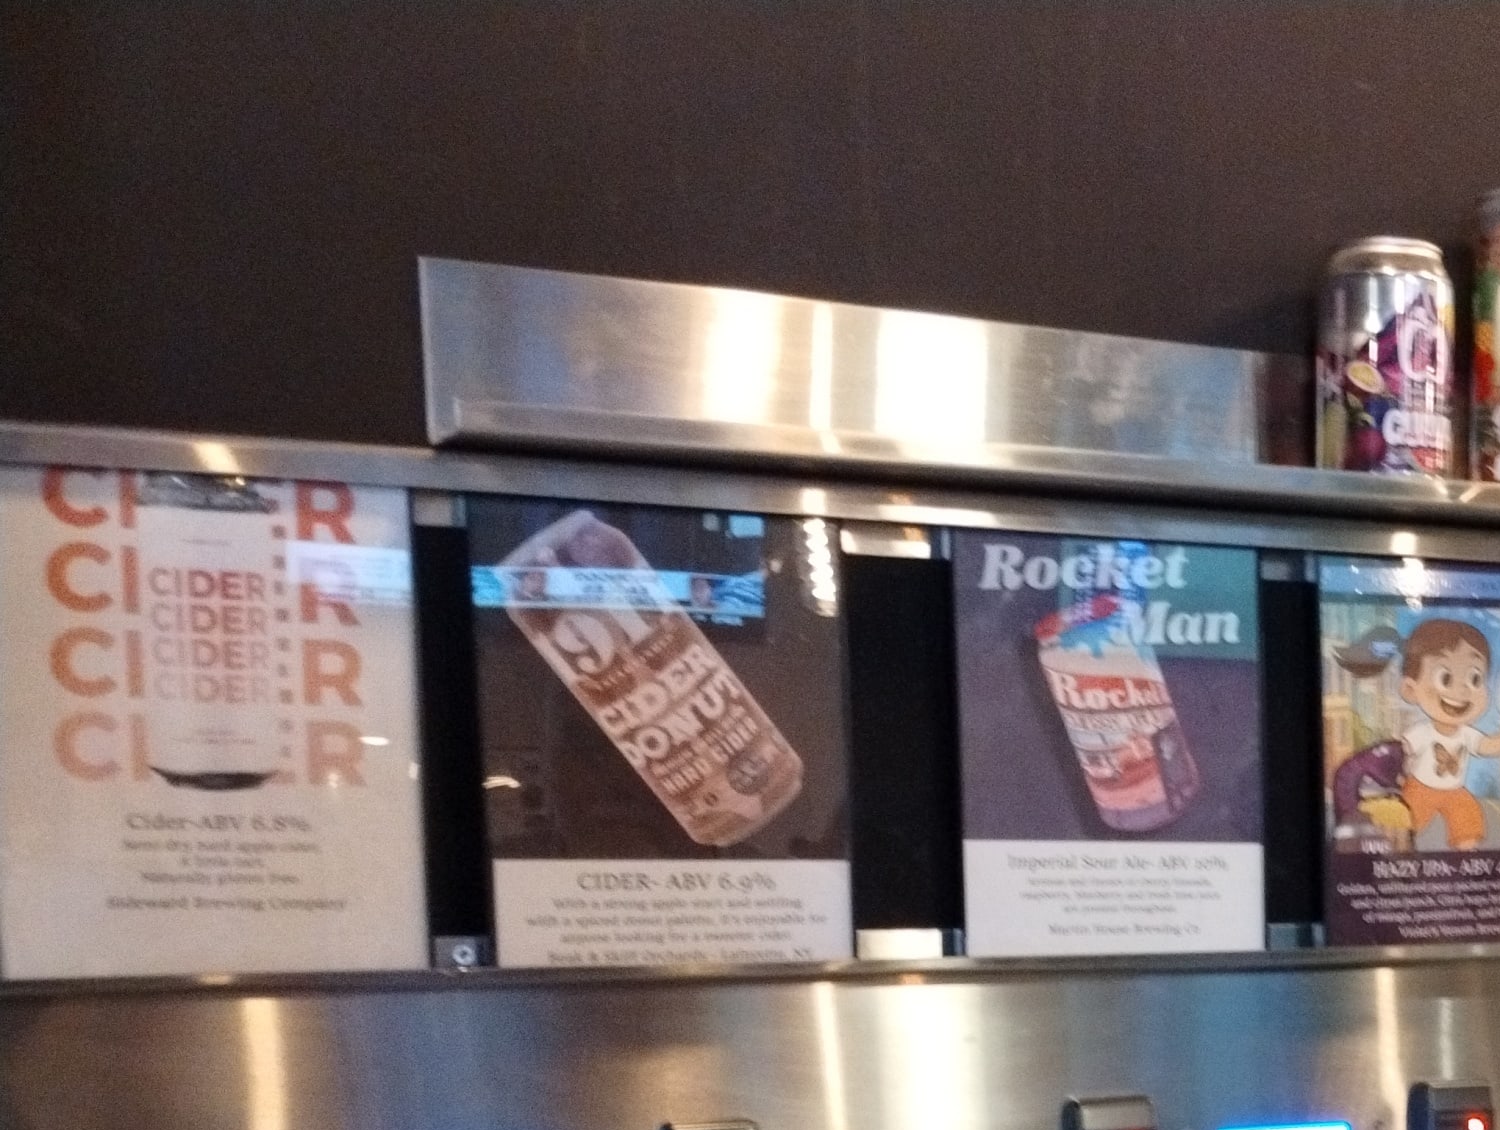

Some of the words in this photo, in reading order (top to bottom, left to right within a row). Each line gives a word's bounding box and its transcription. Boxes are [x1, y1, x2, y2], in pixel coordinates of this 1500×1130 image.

[979, 543, 1189, 592] Rocket
[151, 568, 265, 599] CIDER
[152, 604, 268, 634] CIDER
[1118, 601, 1240, 646] Man
[152, 637, 270, 669] CIDER
[576, 872, 658, 891] CIDER-
[665, 872, 712, 890] ABV
[1372, 860, 1420, 879] HAZY
